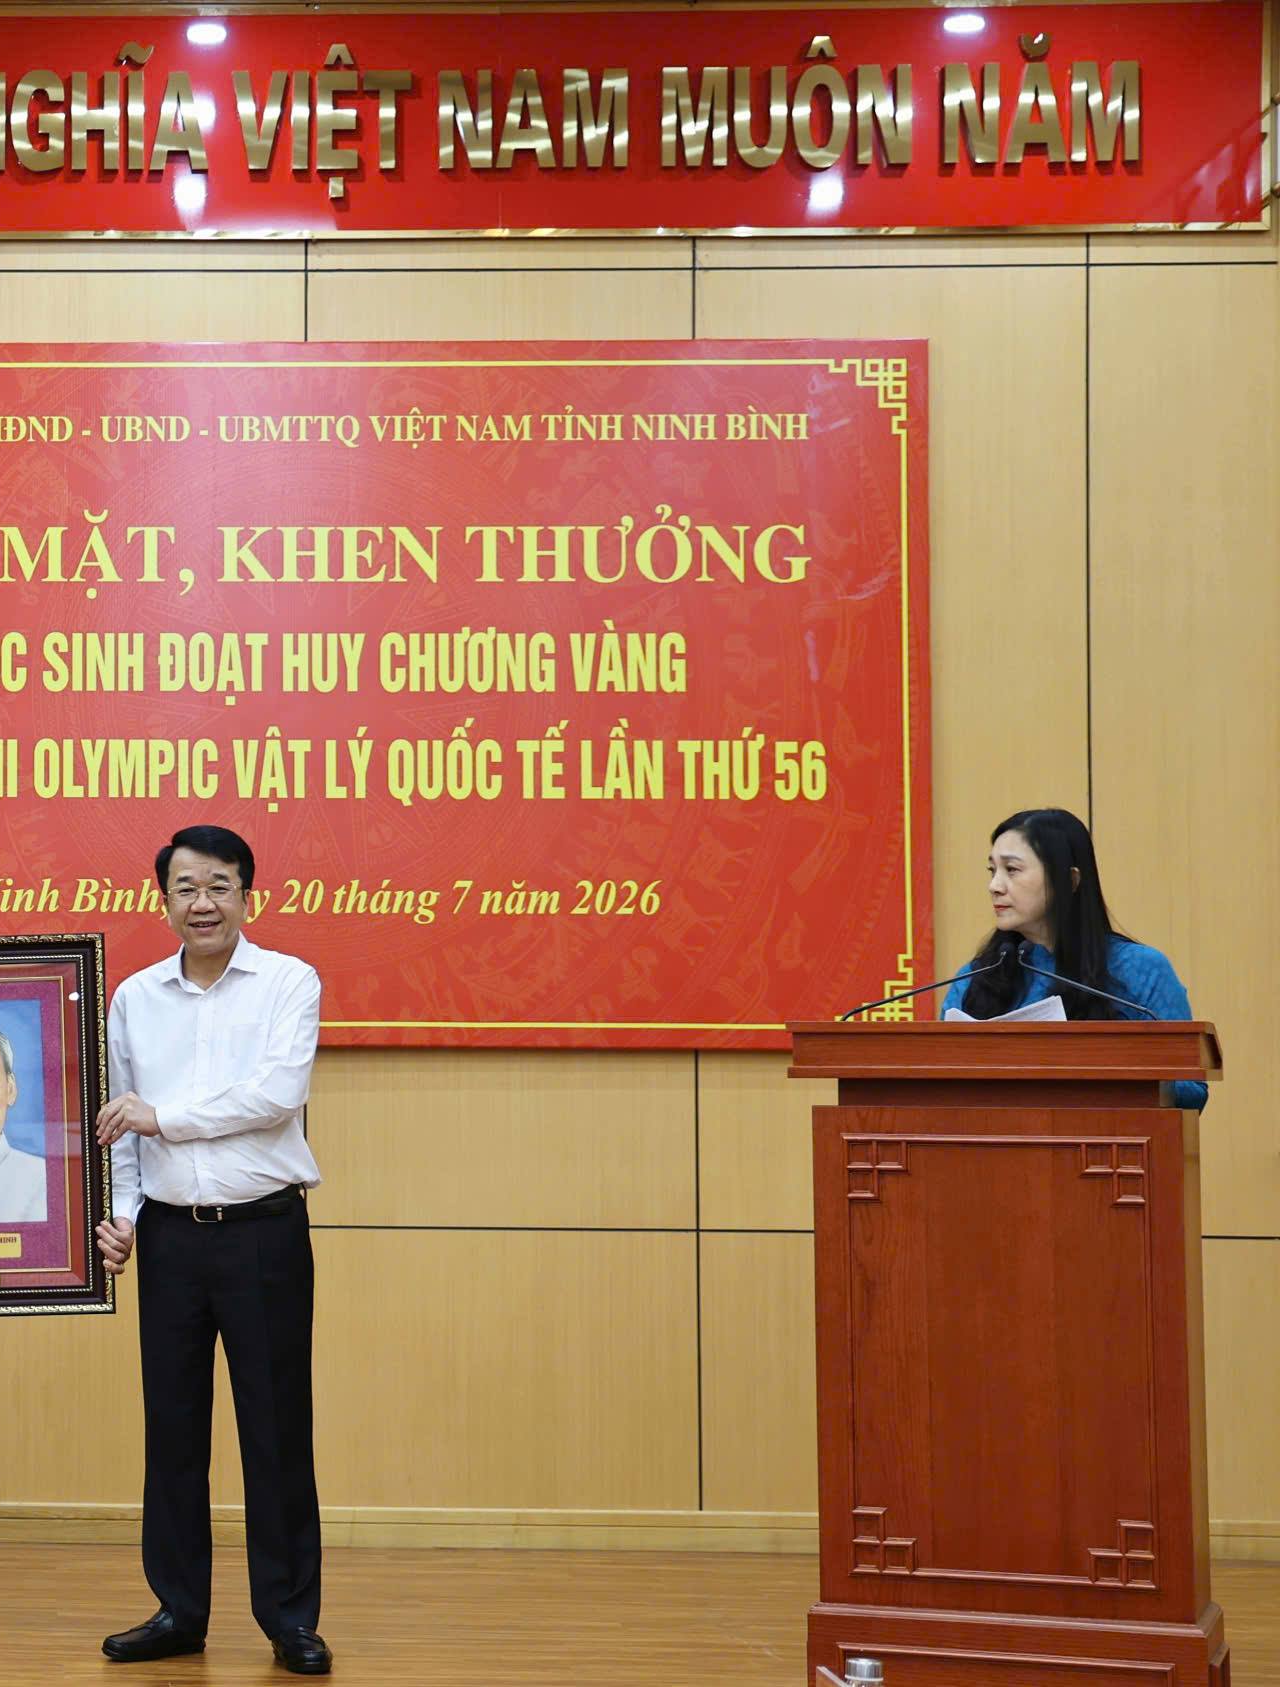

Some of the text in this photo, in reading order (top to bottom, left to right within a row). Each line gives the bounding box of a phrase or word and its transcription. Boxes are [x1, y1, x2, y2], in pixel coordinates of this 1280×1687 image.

[232, 44, 413, 199] VIỆT
[438, 68, 629, 169] NAM
[661, 36, 913, 169] MUÔN
[942, 32, 1141, 164] NĂM
[101, 415, 191, 442] UBND
[218, 414, 360, 448] UBMTTQ
[369, 407, 448, 449] VIỆT
[456, 414, 533, 442] NAM
[541, 405, 625, 442] TỈNH
[632, 413, 717, 441] NINH
[725, 405, 810, 440] BÌNH
[217, 525, 444, 582] KHEN
[464, 504, 812, 583] THƯỞNG
[42, 631, 145, 692] SINH
[158, 631, 269, 706] ĐOẠT
[282, 632, 366, 692] HUY
[379, 626, 556, 692] CHƯƠNG
[569, 620, 687, 692] VÀNG
[33, 738, 219, 799] OLYMPIC
[232, 725, 312, 812] VẬT
[325, 726, 373, 799] LÝ
[387, 717, 503, 807] QUỐC
[516, 719, 570, 799] TẾ
[580, 718, 664, 799] LẦN
[677, 726, 765, 800] THỨ
[774, 740, 827, 800] 56
[69, 878, 168, 920] Bình,
[278, 879, 325, 914] 20
[332, 879, 439, 924] tháng
[452, 880, 474, 914] 7
[479, 879, 560, 914] năm
[570, 879, 664, 915] 2026
